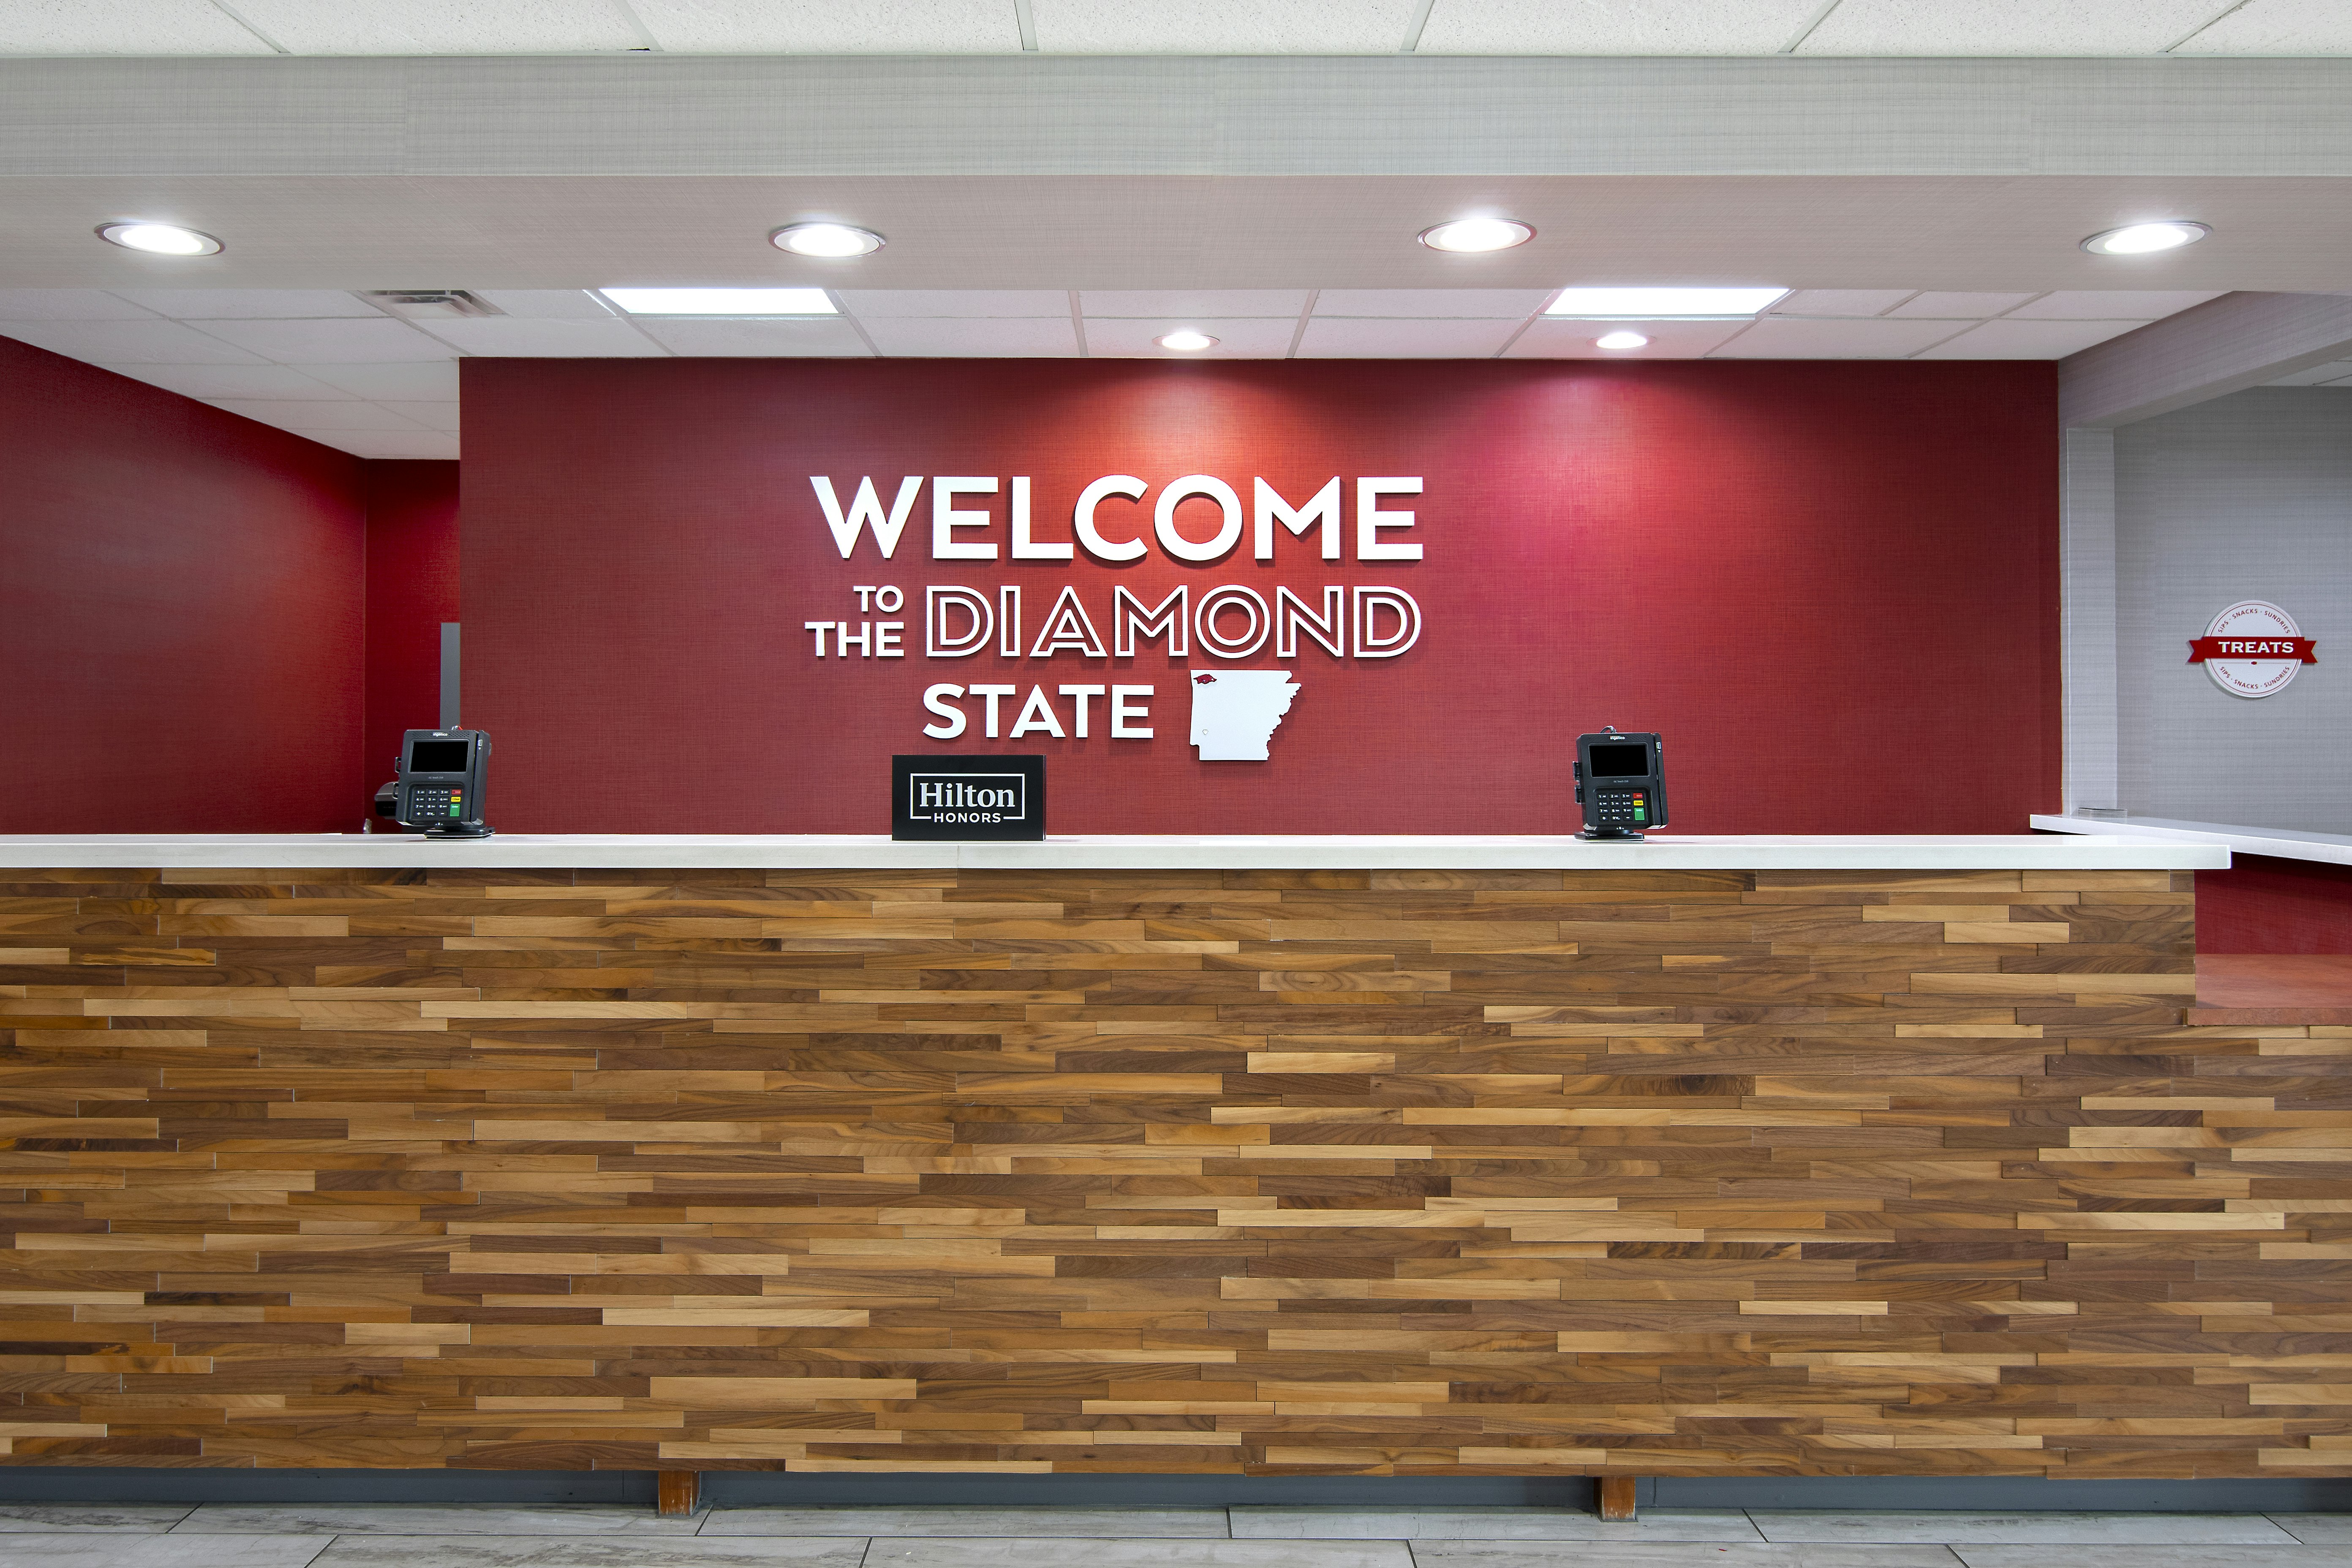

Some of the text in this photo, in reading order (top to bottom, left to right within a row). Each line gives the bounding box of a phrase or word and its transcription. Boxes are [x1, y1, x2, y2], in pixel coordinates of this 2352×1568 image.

[810, 475, 1423, 561] WELCOME
[853, 585, 904, 612] TO
[926, 584, 1421, 659] DIAMOND
[2218, 609, 2290, 634] SIPS SNACKS SUNDRIES
[805, 621, 904, 657] THE
[2218, 641, 2294, 653] TREATS
[2220, 666, 2289, 689] SIPS SNACKS SUNDRIES
[923, 683, 1154, 739] STATE
[920, 783, 1015, 807] Hilton
[934, 812, 1001, 823] HONORS
